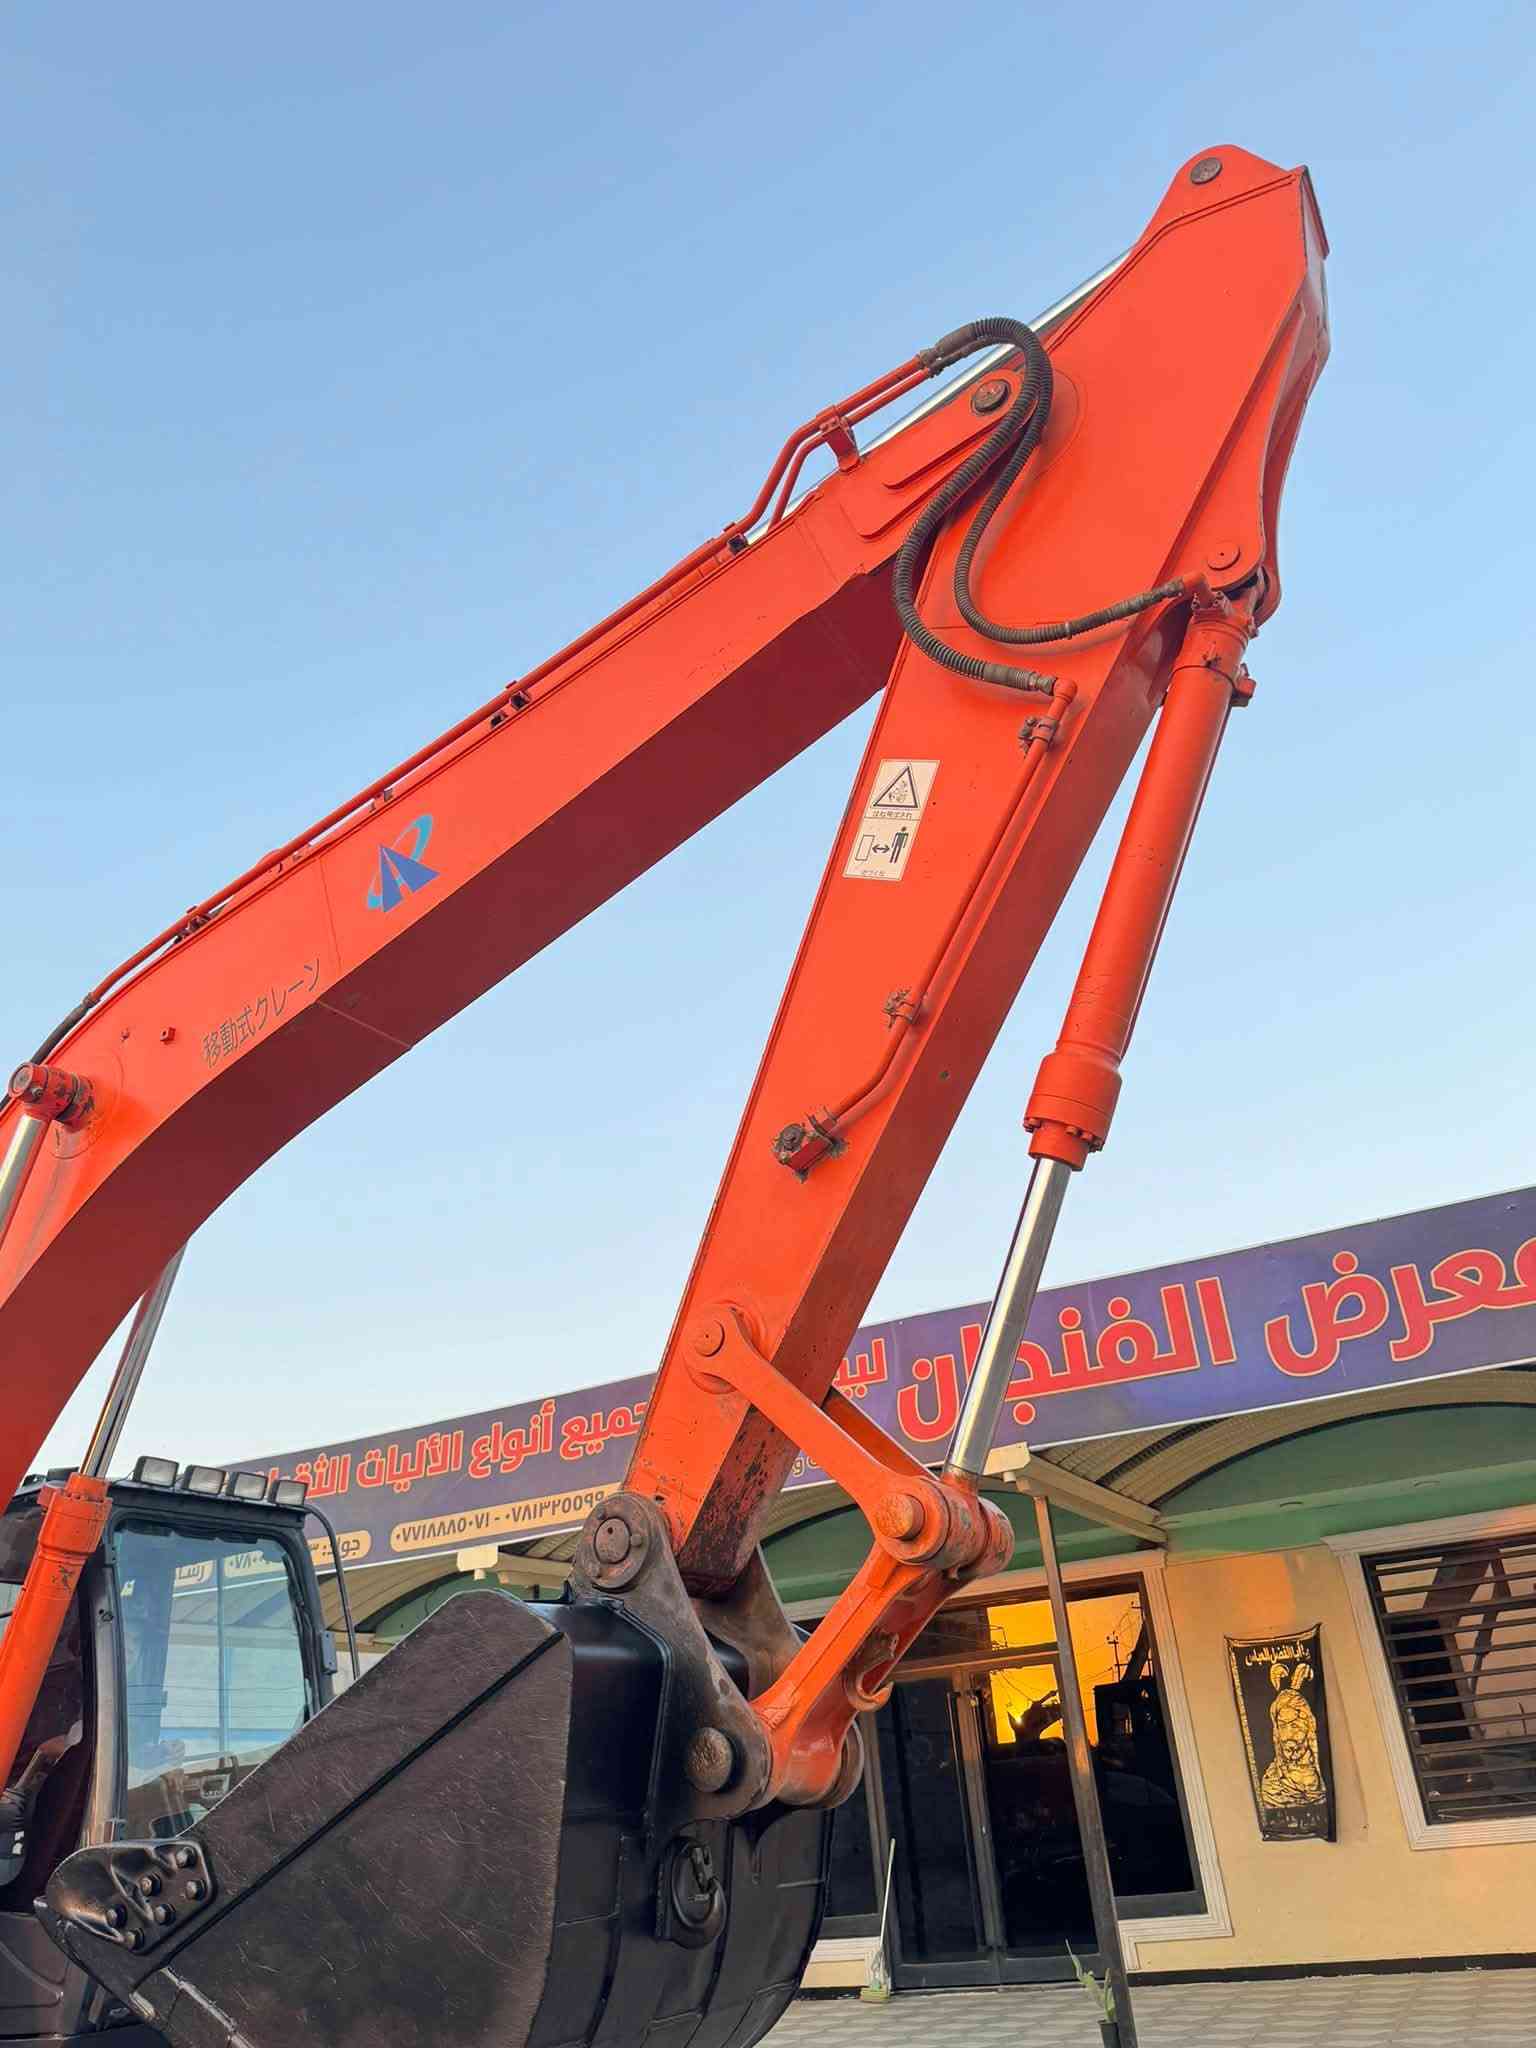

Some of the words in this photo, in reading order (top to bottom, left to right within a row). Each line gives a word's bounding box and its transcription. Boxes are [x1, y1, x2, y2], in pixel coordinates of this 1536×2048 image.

[202, 957, 320, 1069] 移動式クレーン
[468, 1399, 556, 1479] أنواع
